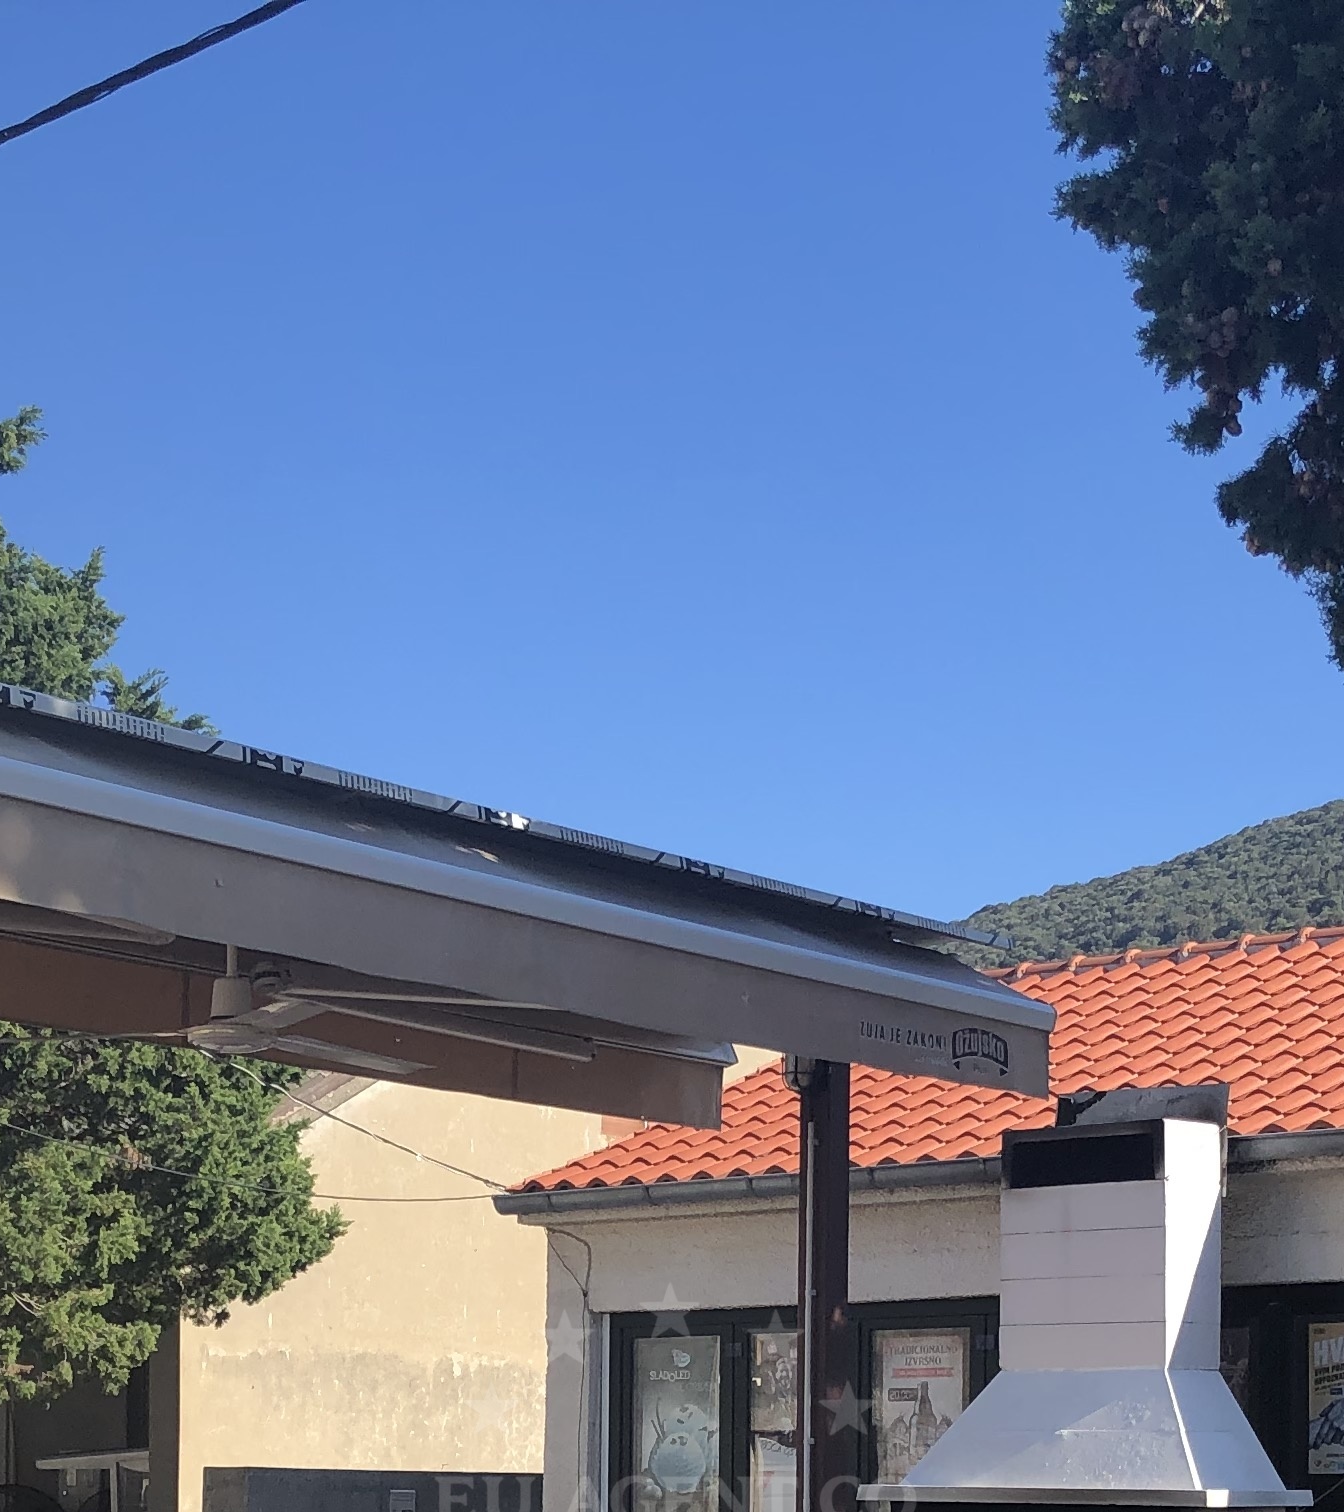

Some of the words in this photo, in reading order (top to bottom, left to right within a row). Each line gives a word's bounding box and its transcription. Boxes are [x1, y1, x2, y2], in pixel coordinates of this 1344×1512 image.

[890, 1027, 901, 1044] JE
[888, 1343, 958, 1356] TRADICIONALNO
[649, 1370, 691, 1383] SLADOLED
